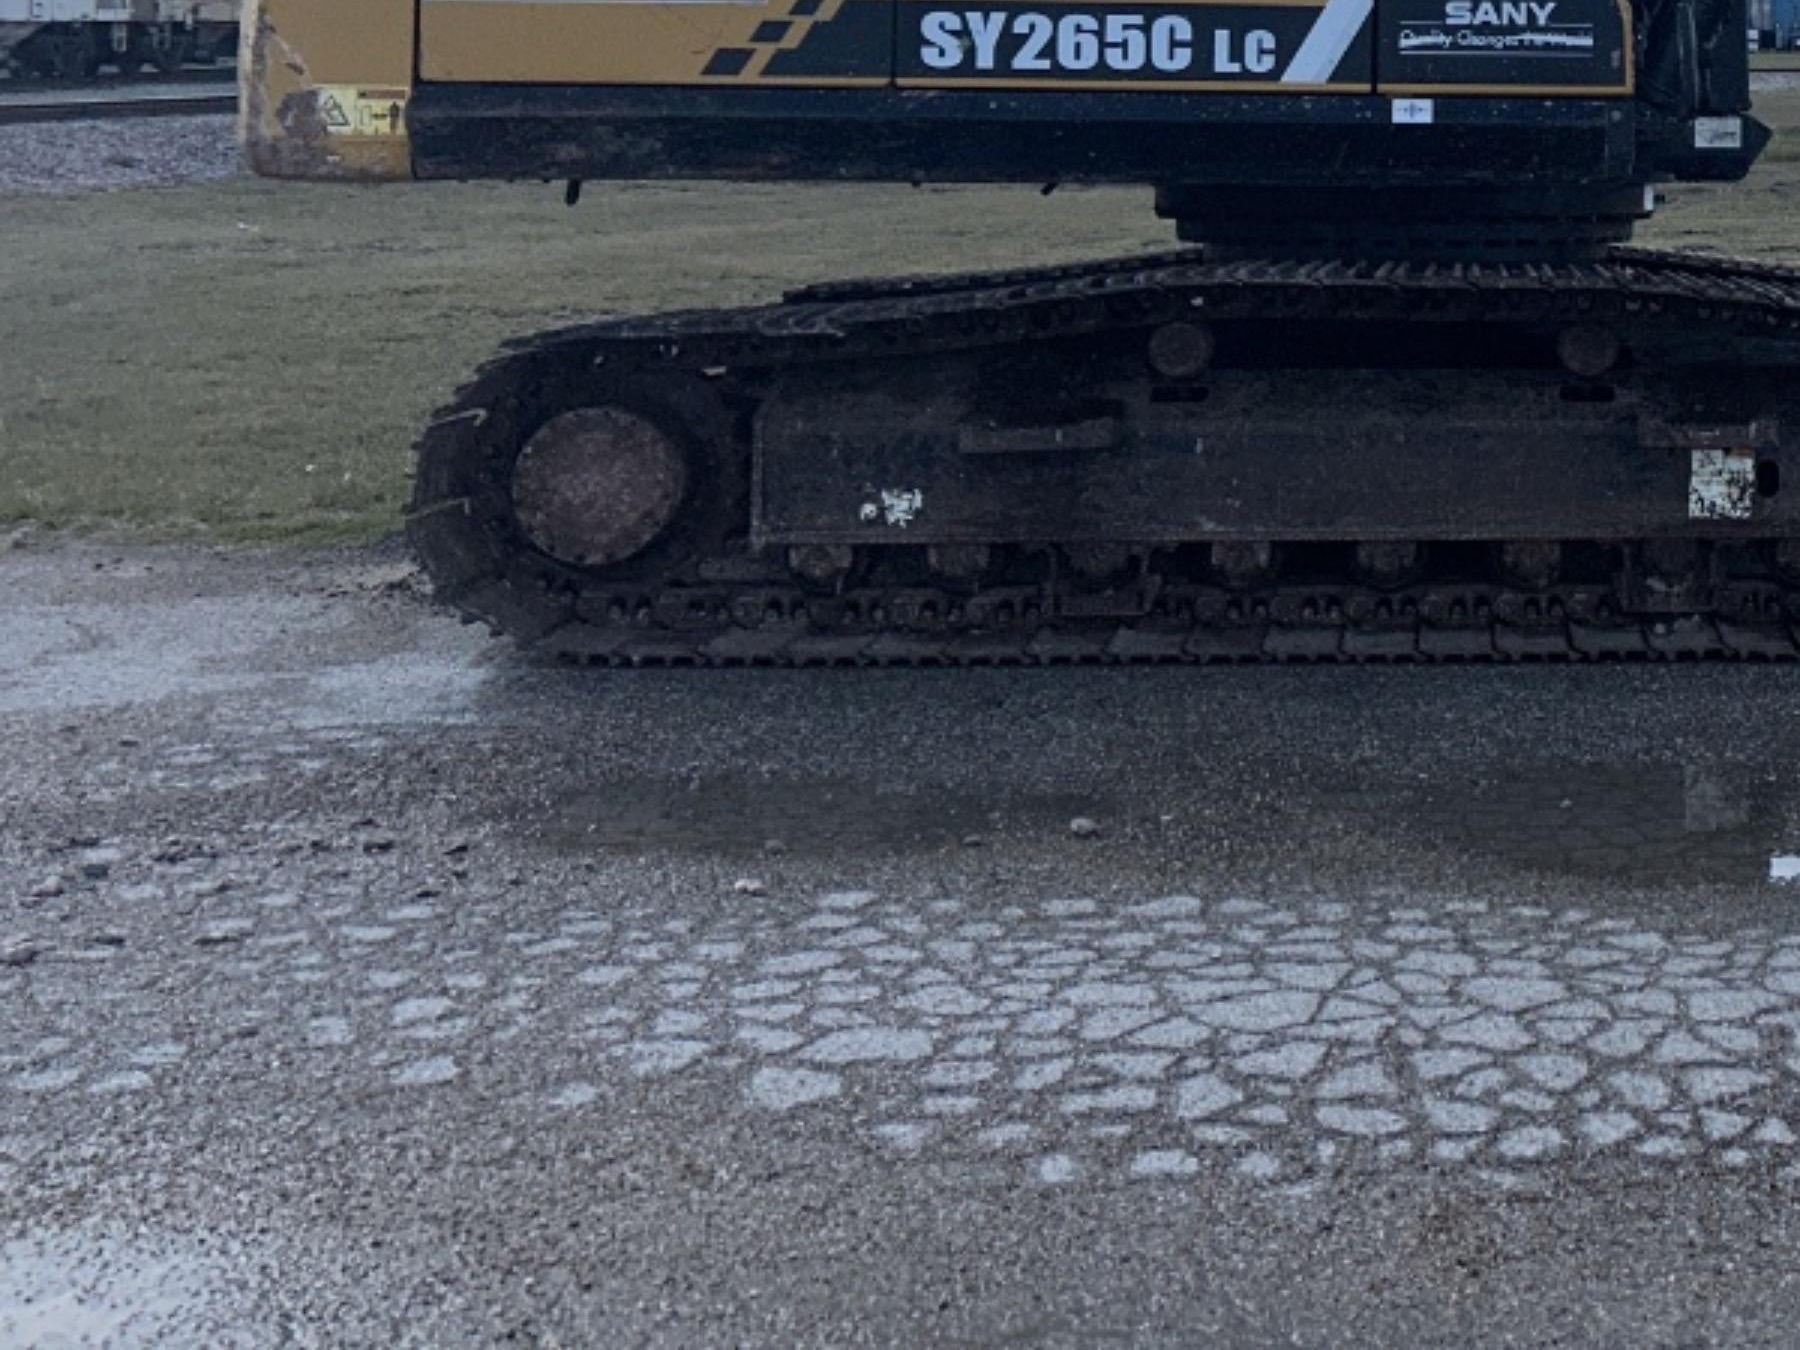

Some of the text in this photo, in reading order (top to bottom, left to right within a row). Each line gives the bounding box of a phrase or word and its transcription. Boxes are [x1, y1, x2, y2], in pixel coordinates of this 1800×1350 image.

[1444, 0, 1557, 26] SANY
[919, 11, 1277, 74] SY265C LC
